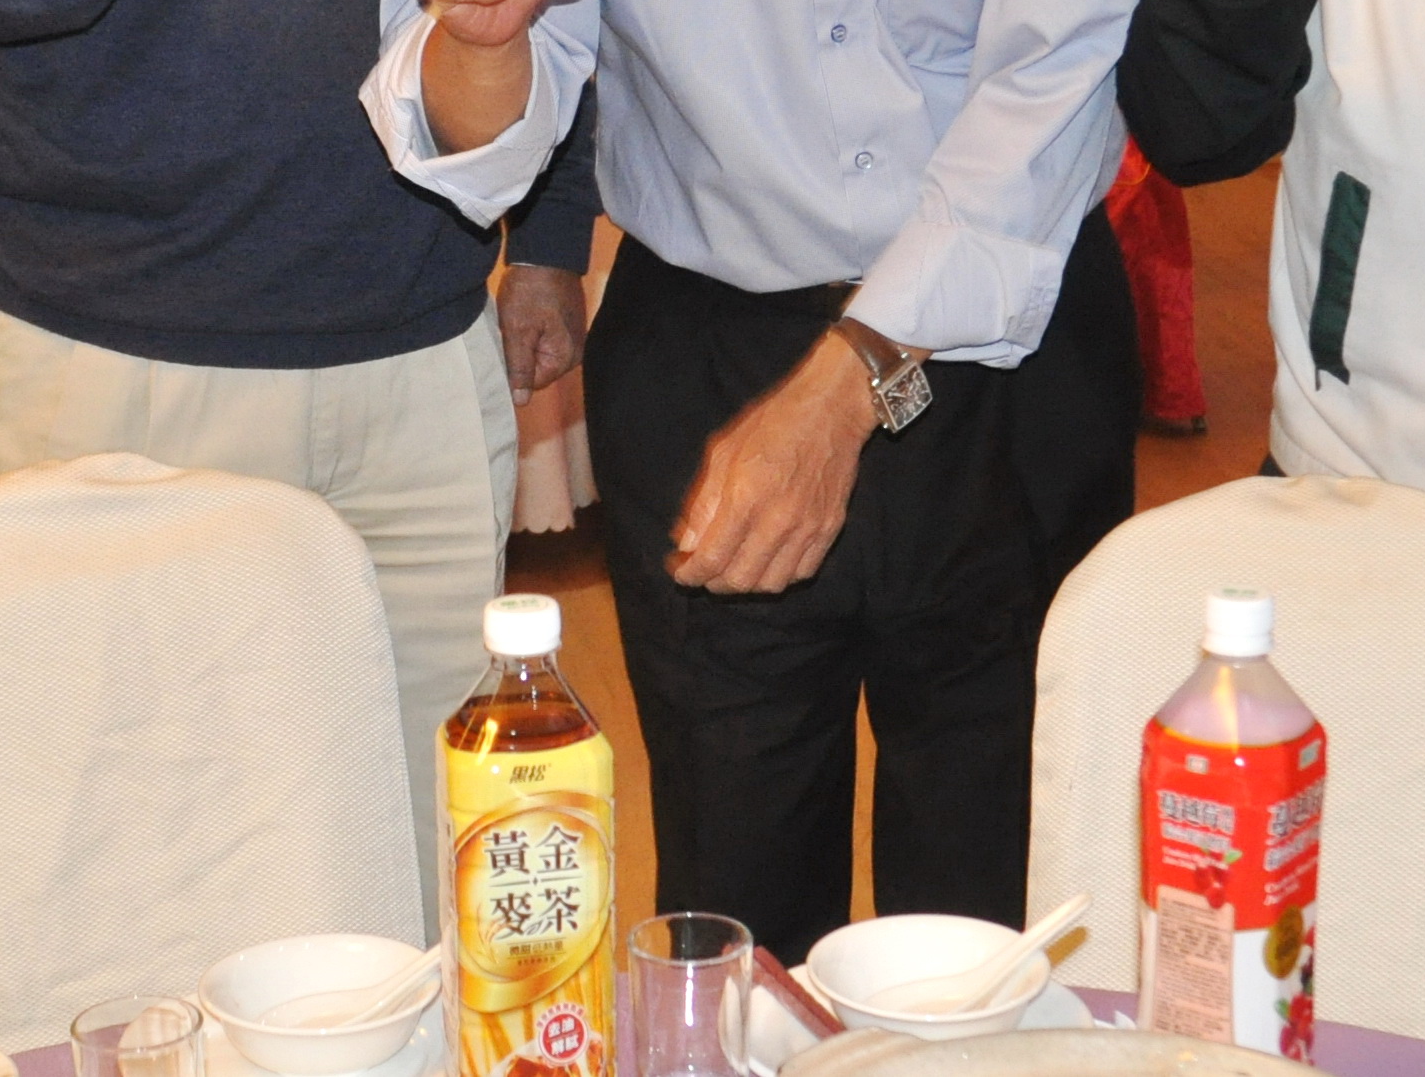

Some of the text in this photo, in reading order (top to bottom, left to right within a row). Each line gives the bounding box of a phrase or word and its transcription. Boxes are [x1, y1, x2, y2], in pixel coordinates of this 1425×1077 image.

[509, 764, 546, 784] 黑松
[484, 825, 580, 879] 黃金
[489, 886, 581, 940] 麥茶
